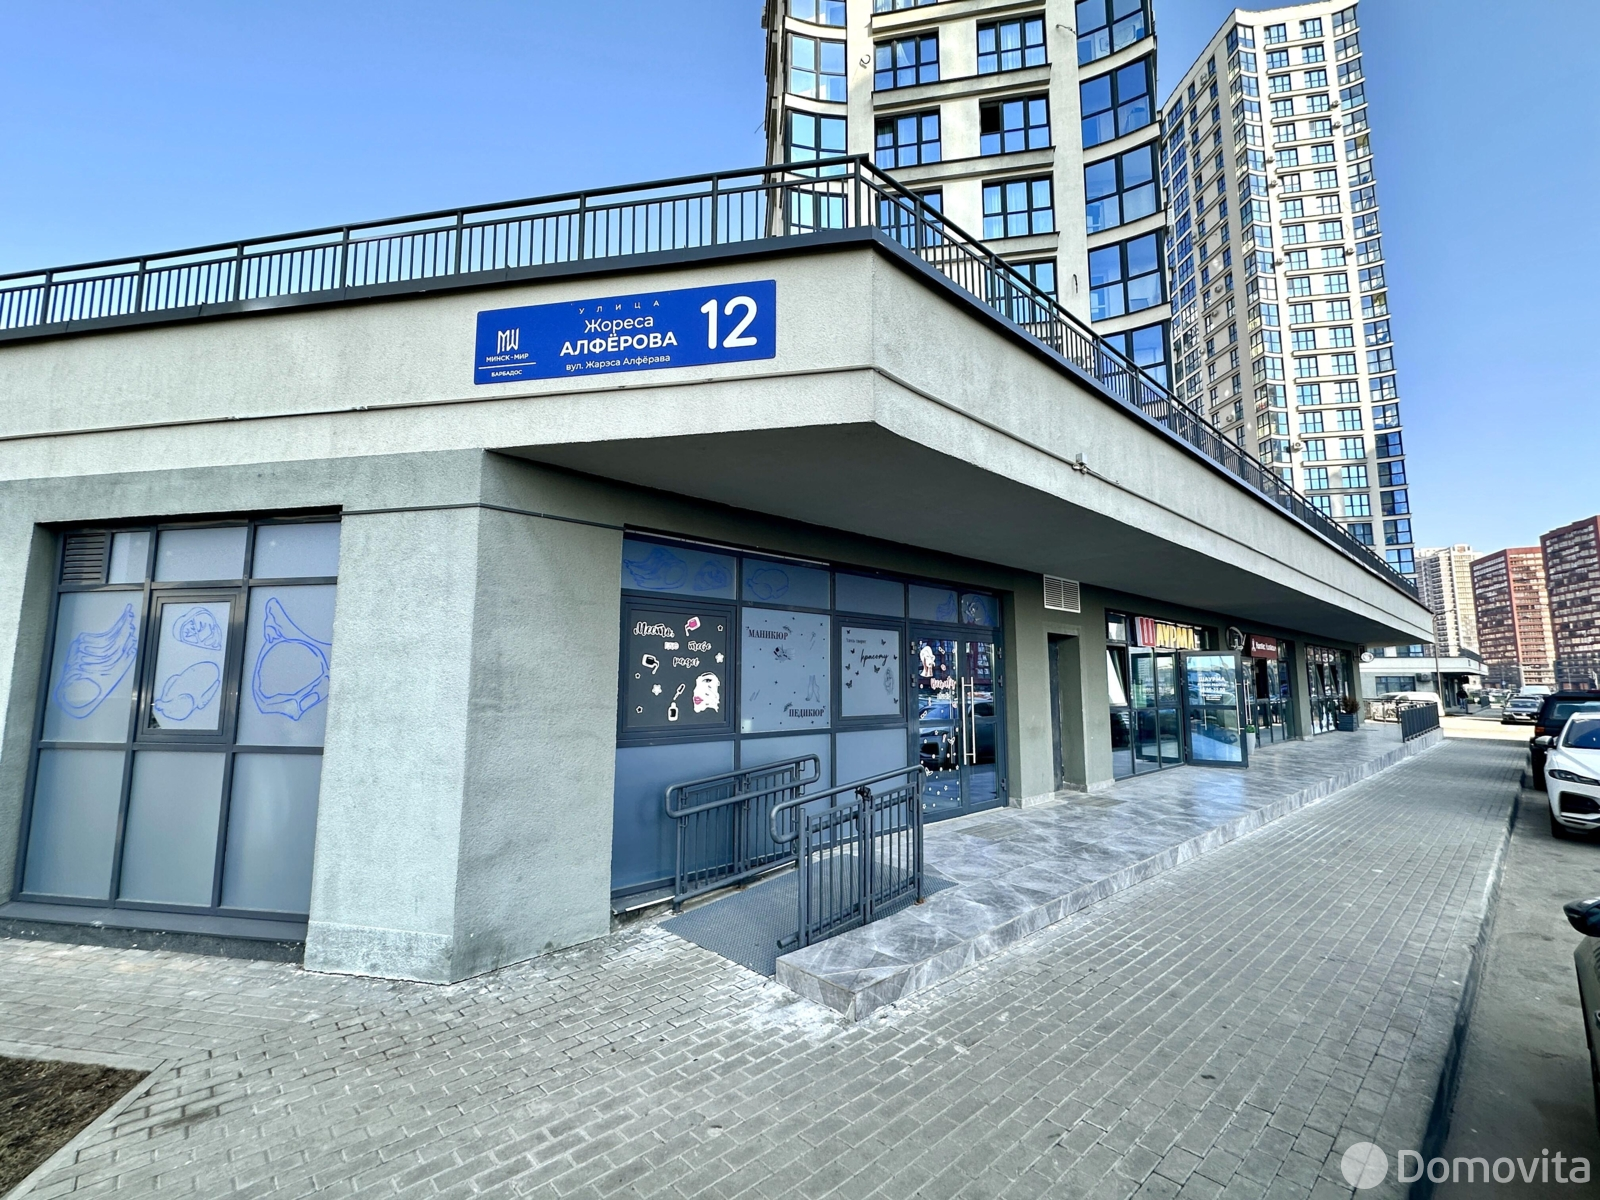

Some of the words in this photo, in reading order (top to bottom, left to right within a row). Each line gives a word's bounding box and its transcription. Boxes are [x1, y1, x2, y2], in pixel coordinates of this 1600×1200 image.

[584, 316, 654, 337] Жореса
[700, 295, 758, 350] 12
[559, 331, 678, 357] АЛФЁРОВА
[485, 353, 529, 363] МИНСК-МИР
[565, 361, 584, 371] вул.
[585, 358, 621, 370] Жарэса
[622, 354, 671, 366] Алфёрава
[491, 369, 523, 377] БАРБАДОС
[748, 629, 789, 641] МАНИКЮР
[1135, 617, 1195, 651] ШАУРМА
[788, 708, 825, 718] ПЕДИКЮР
